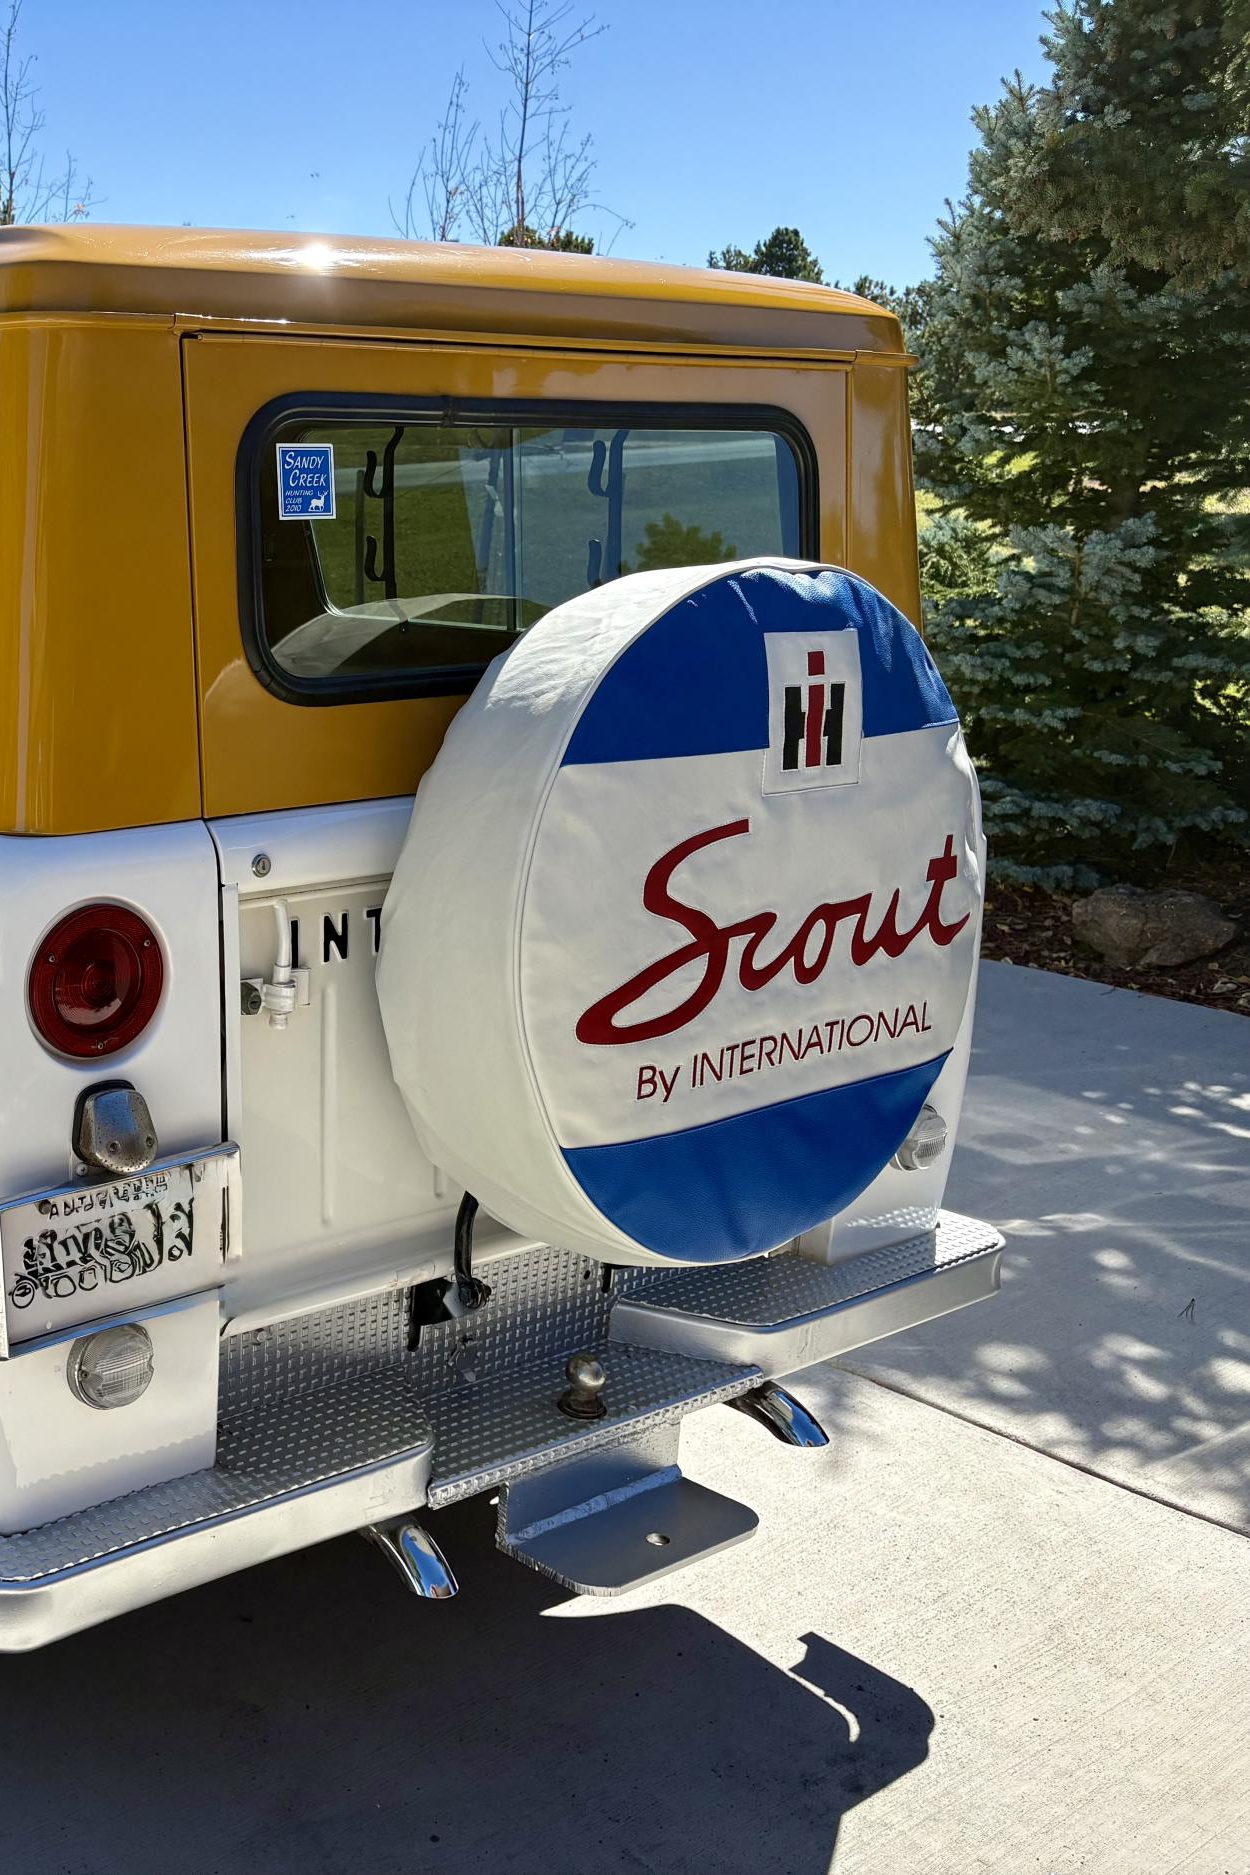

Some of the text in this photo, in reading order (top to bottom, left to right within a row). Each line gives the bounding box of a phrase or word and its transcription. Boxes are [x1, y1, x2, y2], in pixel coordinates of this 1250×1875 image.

[284, 451, 325, 469] SANDY
[289, 469, 327, 487] CREEK
[574, 818, 971, 1046] Scout
[636, 1000, 933, 1103] By INTERNATIONAL
